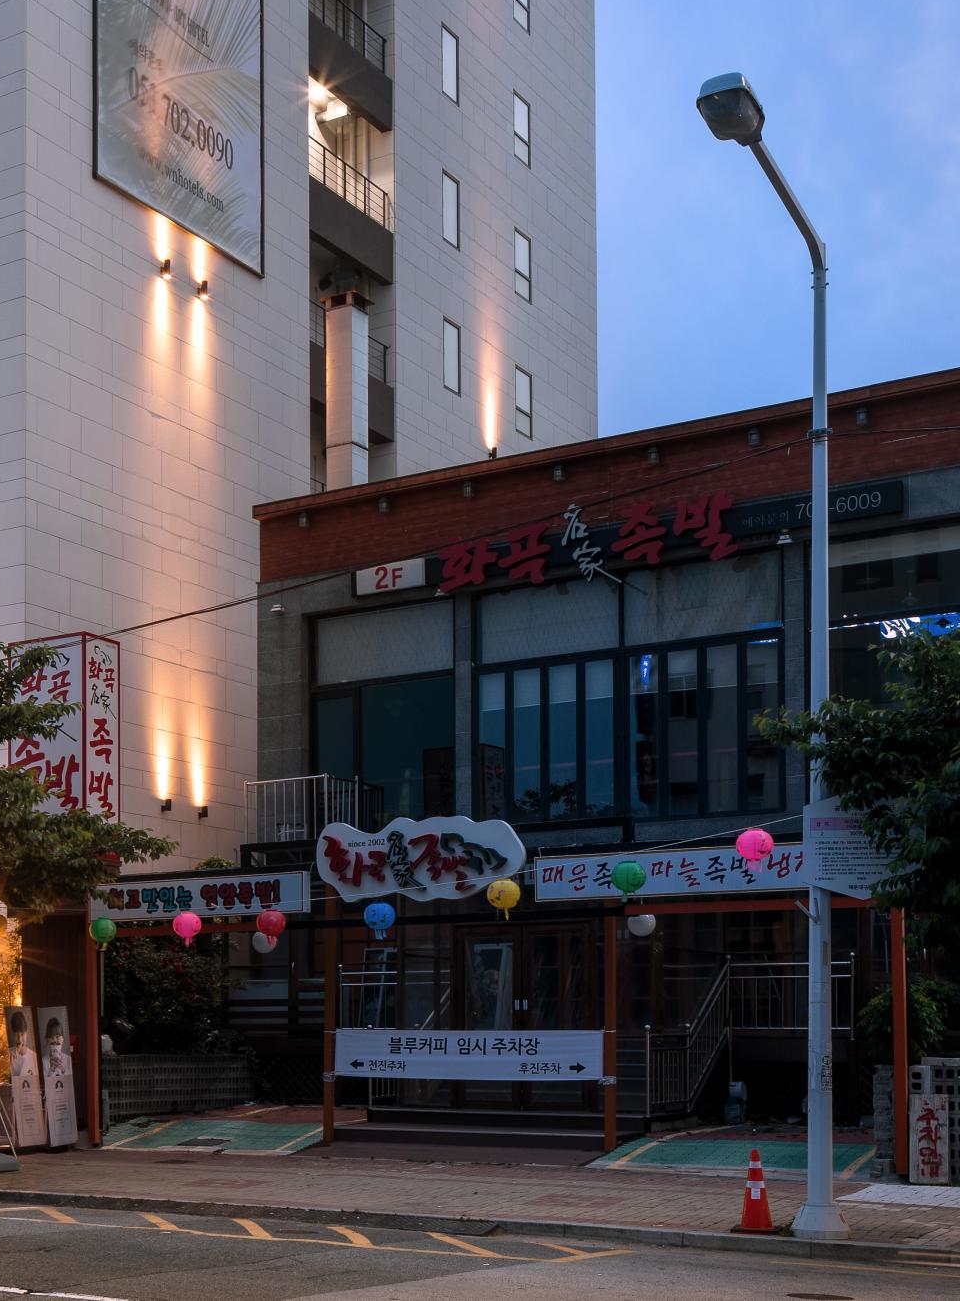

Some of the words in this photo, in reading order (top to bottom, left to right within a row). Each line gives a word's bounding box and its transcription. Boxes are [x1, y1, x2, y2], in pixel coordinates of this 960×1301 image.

[437, 522, 552, 594] 화곡
[611, 496, 739, 568] 족발
[375, 565, 403, 590] 2F
[348, 839, 366, 848] since
[367, 838, 385, 847] 2002
[388, 1036, 448, 1055] 블루커피
[456, 1037, 487, 1056] 임시
[491, 1037, 540, 1056] 주차장
[368, 1059, 407, 1072] 전진주차
[519, 1062, 561, 1075] 후진주차
